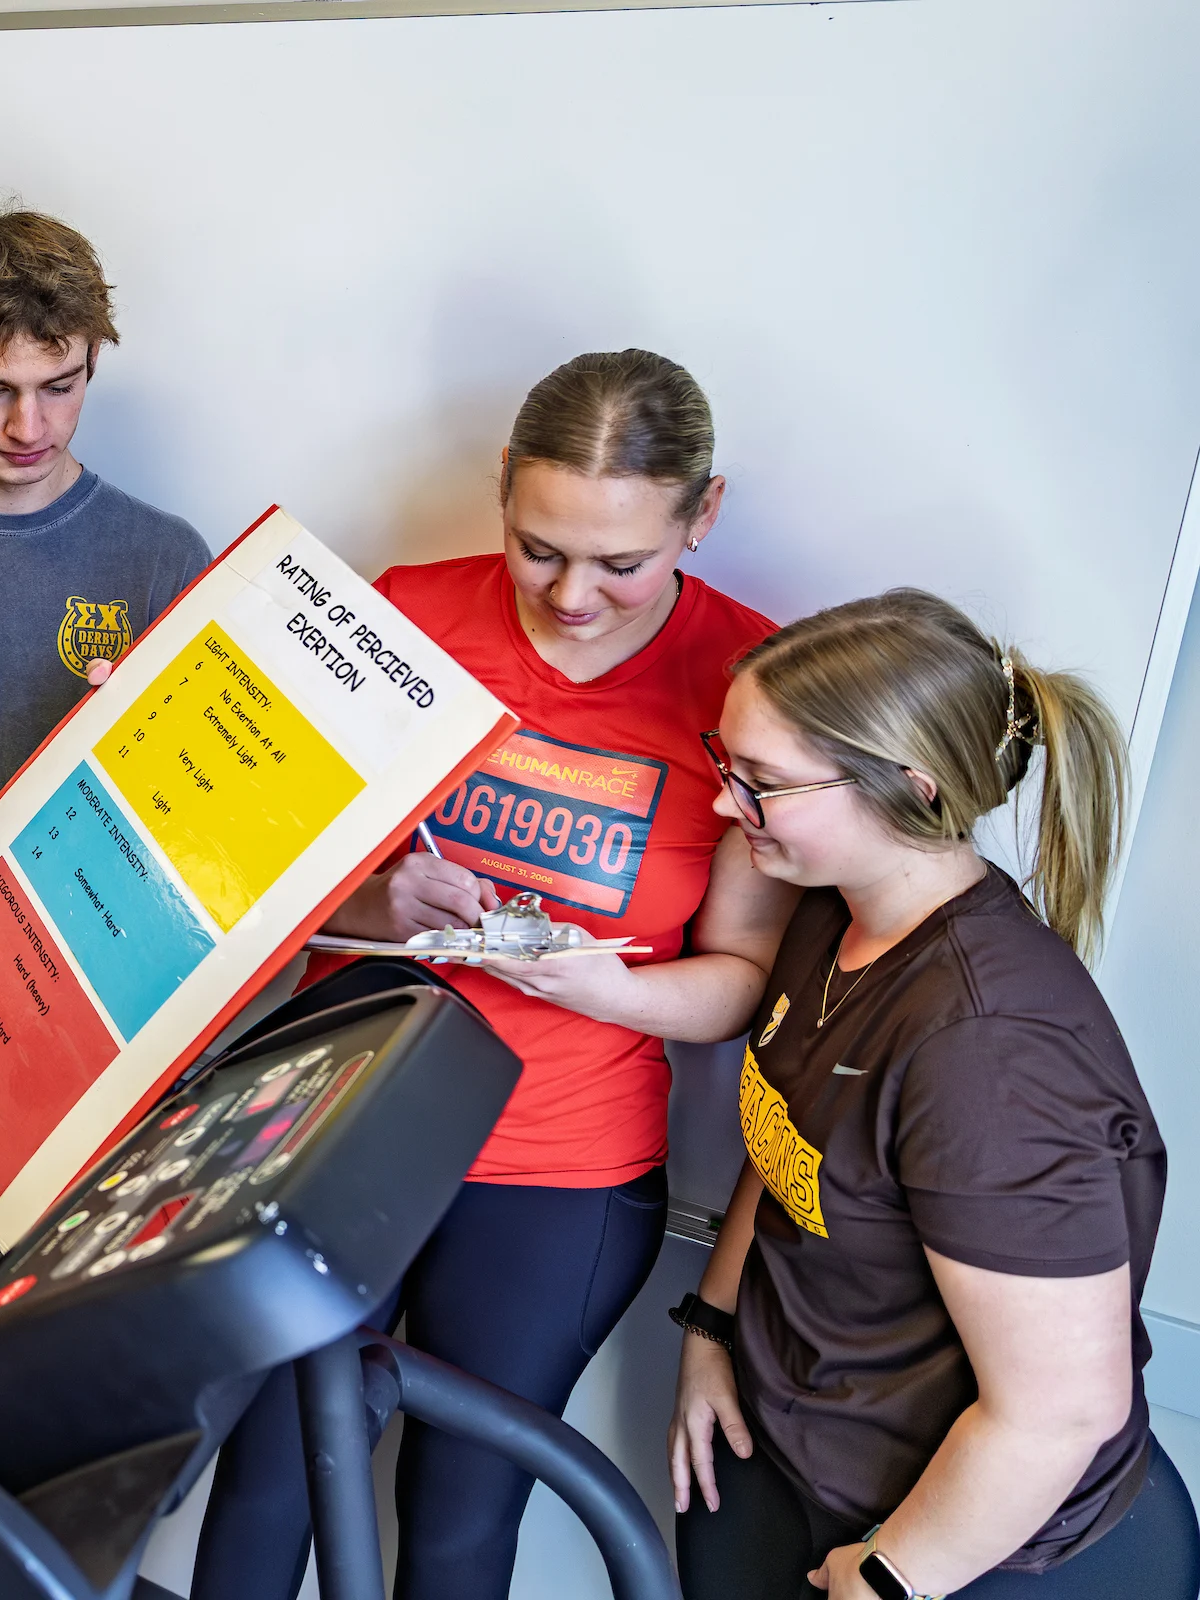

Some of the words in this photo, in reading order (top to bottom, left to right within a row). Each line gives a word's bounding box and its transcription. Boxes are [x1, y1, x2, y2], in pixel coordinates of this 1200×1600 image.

[78, 630, 117, 646] DERBY
[80, 643, 113, 658] DAYS
[276, 554, 331, 607] RATING
[327, 605, 356, 627] OF
[349, 624, 435, 709] PERCIEVED
[286, 612, 366, 692] EXERTION
[163, 694, 173, 704] 8
[204, 636, 230, 663] LIGHT
[225, 660, 272, 712] INTENSITY:
[133, 728, 145, 742] 10
[179, 677, 189, 687] 7
[203, 706, 239, 749] Extremely
[236, 745, 258, 770] Light
[195, 661, 204, 671] 6
[219, 688, 232, 705] No
[230, 701, 261, 738] Exertion
[260, 737, 273, 750] At
[270, 750, 287, 764] All
[118, 745, 130, 758] 11
[152, 790, 172, 815] Light
[147, 711, 157, 720] 9
[178, 748, 196, 773] Very
[193, 768, 214, 793] Light
[65, 806, 77, 821] 12
[77, 779, 113, 828] MODERATE
[108, 824, 149, 882] INTENSITY:
[434, 781, 633, 875] 0619930
[31, 846, 43, 860] 14
[48, 826, 60, 840] 13
[74, 868, 105, 912] Somewhat
[101, 910, 121, 938] Hard
[481, 857, 516, 875] AUGUST
[517, 868, 529, 880] 31,
[530, 872, 554, 885] 2008
[13, 953, 31, 981] Hard
[26, 979, 50, 1016] (heavy)
[22, 922, 60, 983] INTENSITY:
